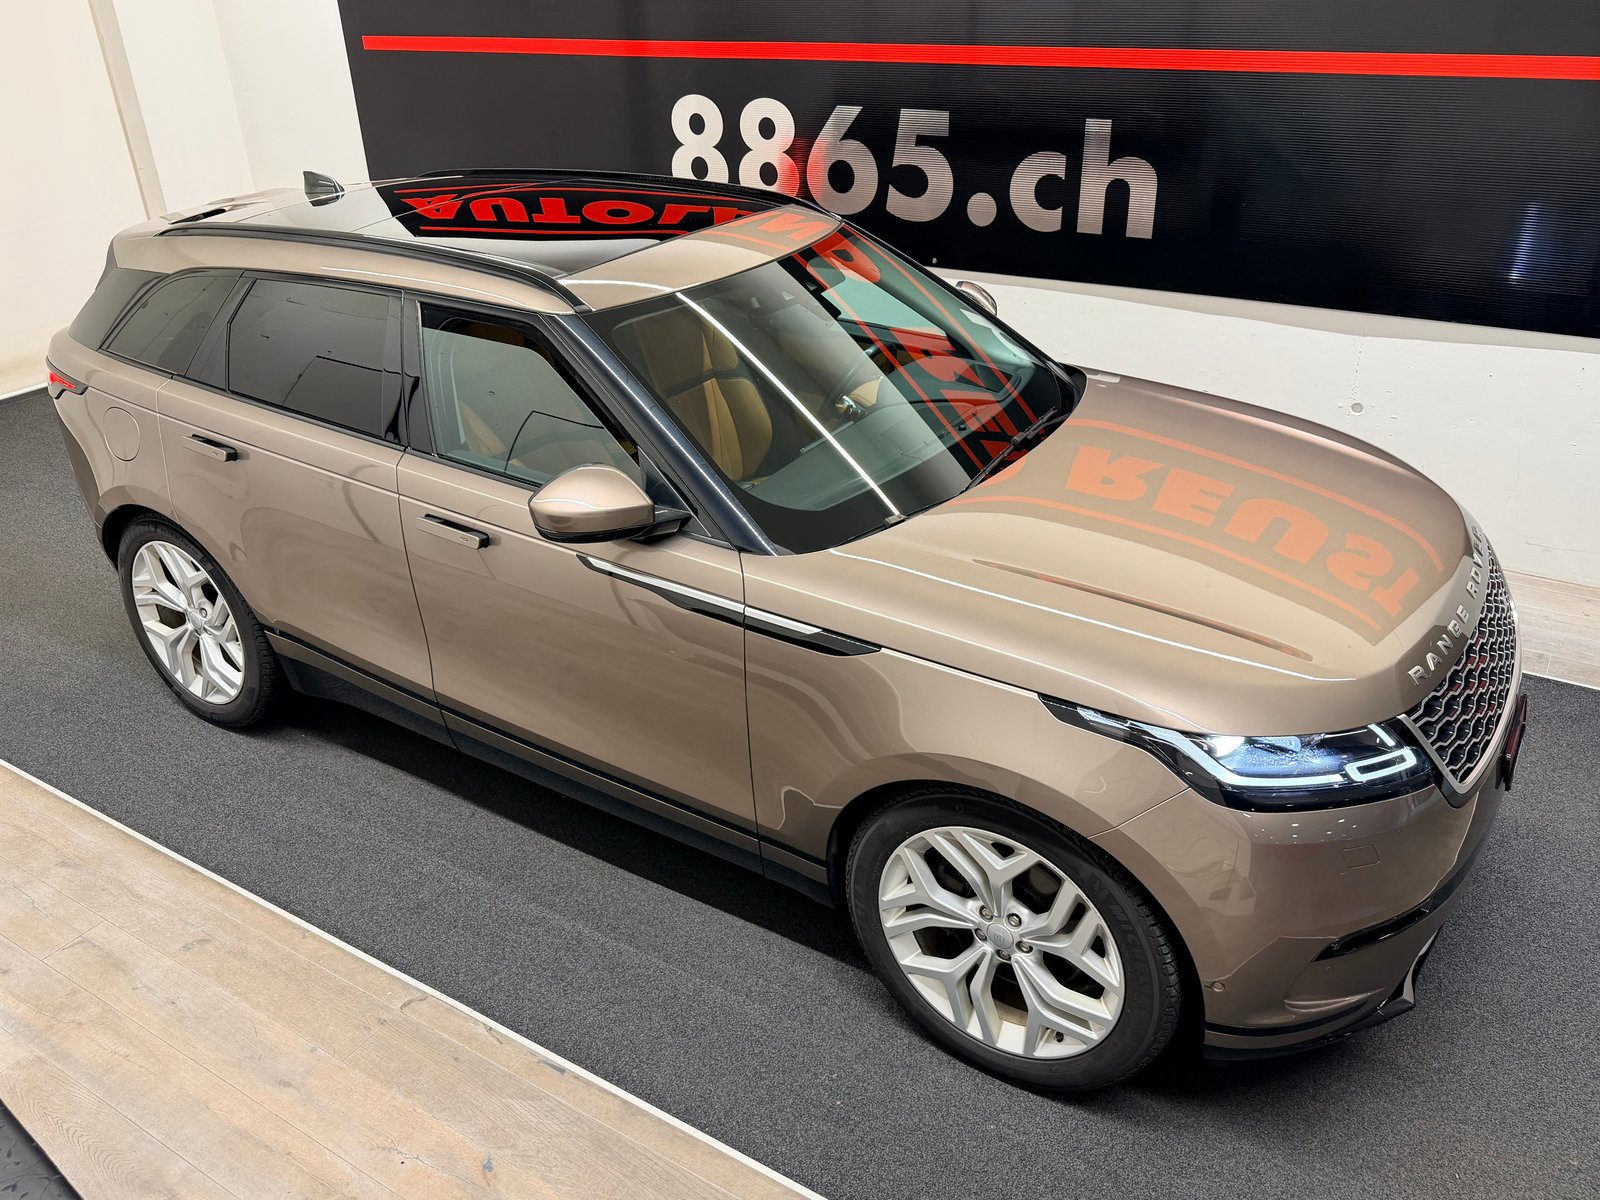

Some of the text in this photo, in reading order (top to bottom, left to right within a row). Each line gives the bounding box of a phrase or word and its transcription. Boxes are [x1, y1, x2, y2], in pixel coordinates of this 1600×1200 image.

[670, 94, 1159, 240] 8865.ch
[1407, 525, 1484, 685] RANGE ROVER
